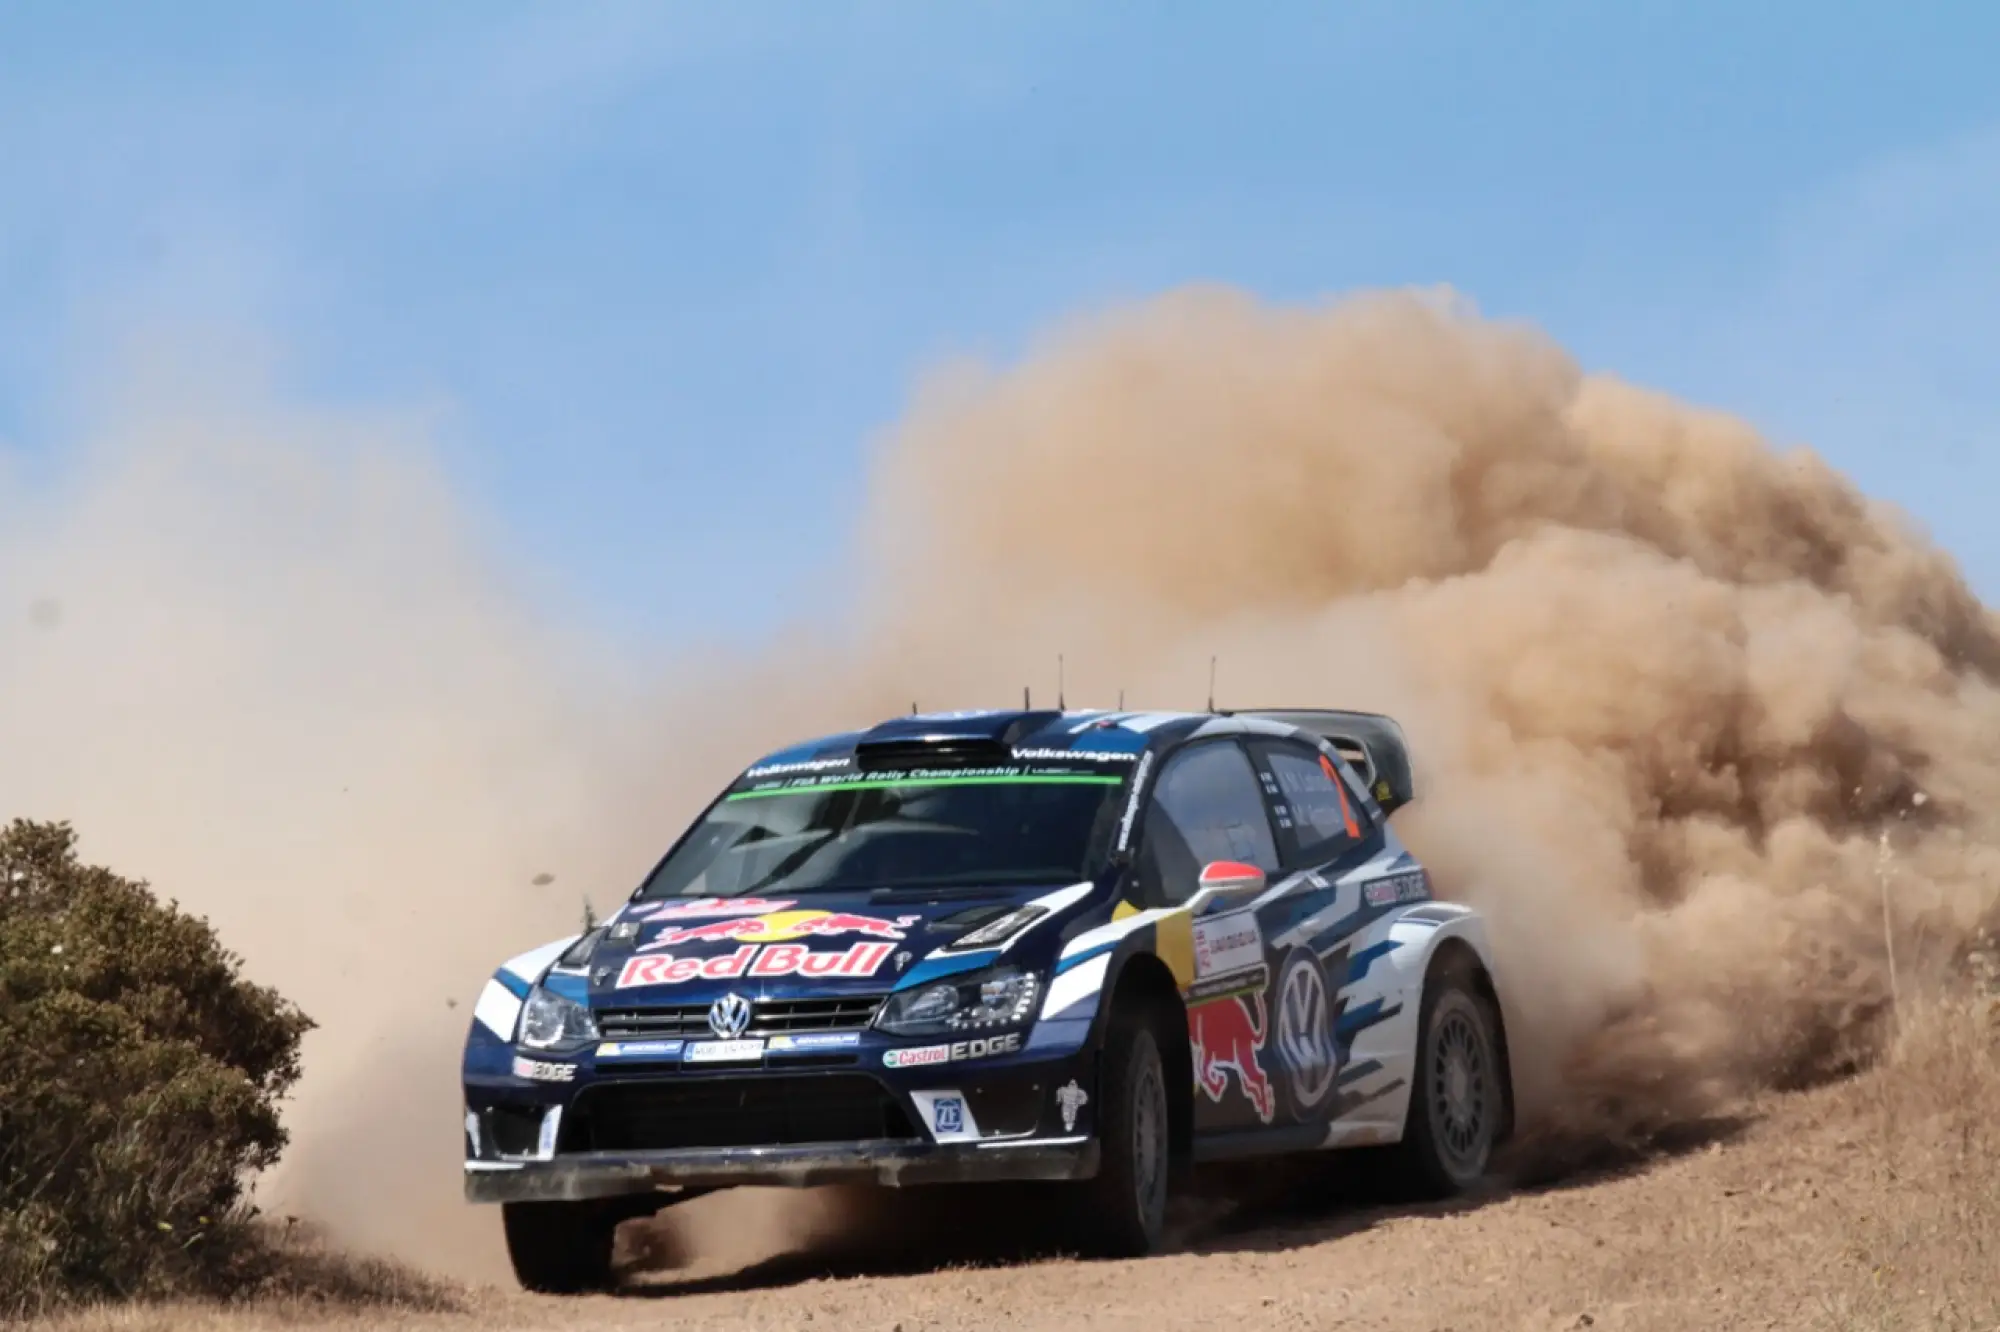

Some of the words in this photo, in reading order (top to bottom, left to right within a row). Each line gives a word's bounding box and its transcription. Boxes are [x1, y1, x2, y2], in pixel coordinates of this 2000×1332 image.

[1011, 746, 1137, 762] Volkswagen
[821, 773, 864, 784] World
[866, 770, 906, 781] Rally
[909, 766, 1020, 779] Championship
[619, 944, 756, 987] Red
[750, 943, 897, 976] Bull
[899, 1048, 945, 1066] Castrol
[951, 1032, 1021, 1061] EDGE
[534, 1062, 578, 1082] EDGE
